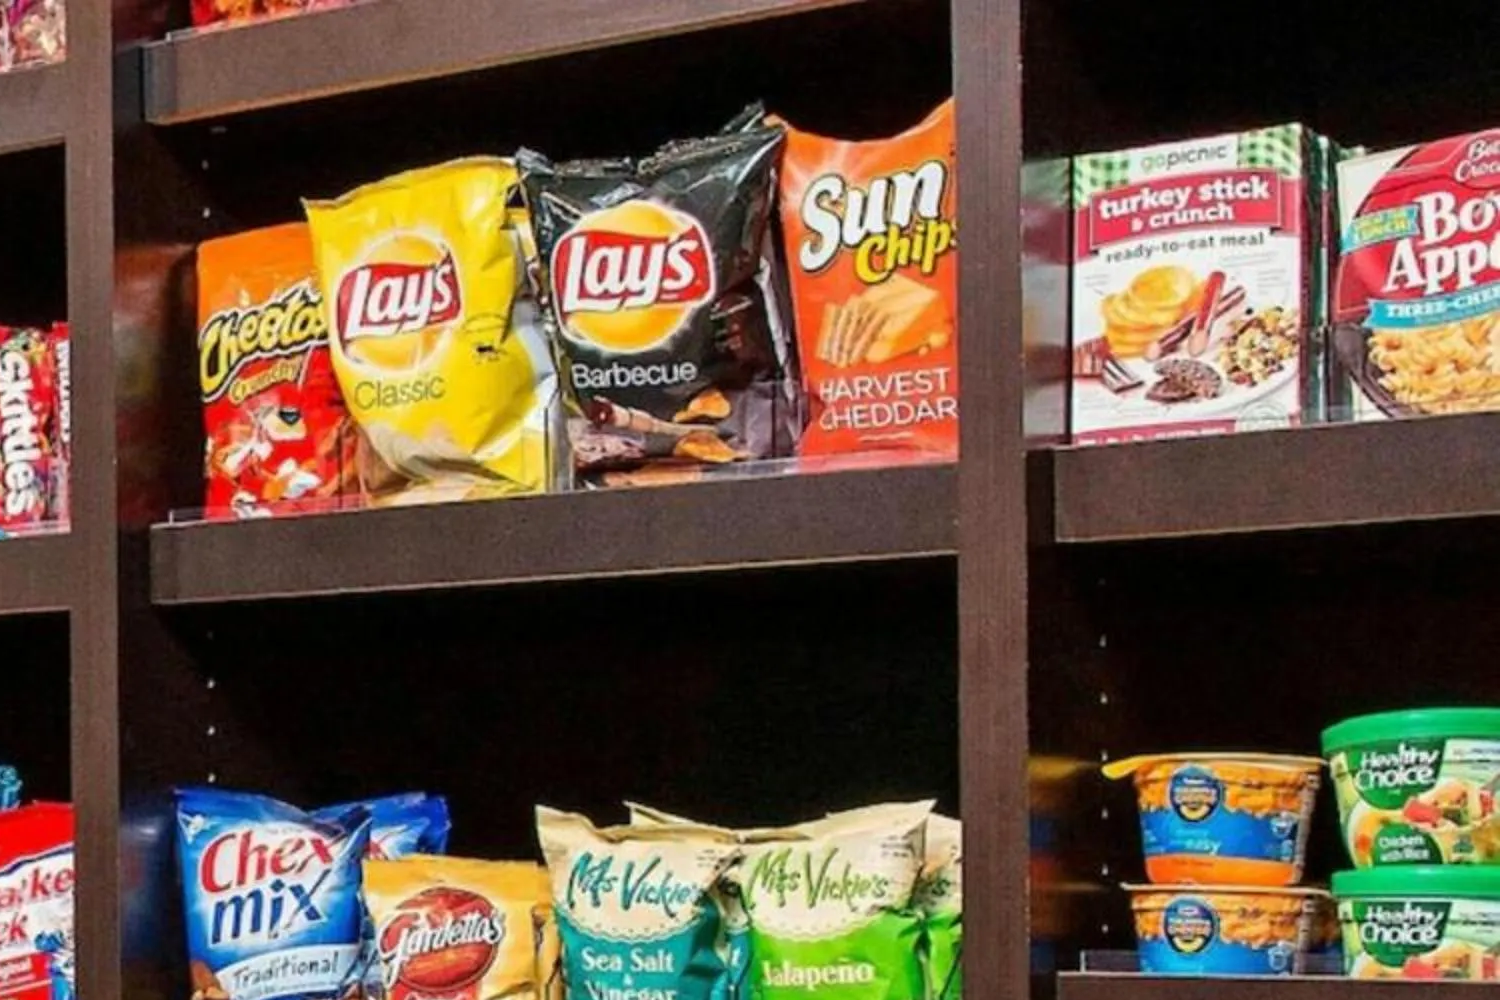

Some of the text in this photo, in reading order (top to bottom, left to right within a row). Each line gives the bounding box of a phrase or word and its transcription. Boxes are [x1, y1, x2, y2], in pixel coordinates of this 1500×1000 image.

[1140, 143, 1230, 173] gopicnic
[1099, 174, 1271, 219] turkey stick
[799, 161, 948, 273] Sun
[1148, 202, 1236, 229] crunch
[1413, 189, 1500, 247] Bo
[1105, 228, 1267, 265] ready-to-eat meal
[562, 228, 701, 313] Lay's
[345, 250, 455, 341] Lay's
[353, 372, 447, 413] Classic
[572, 360, 698, 390] Barbecue
[819, 366, 951, 401] HARVEST
[819, 398, 958, 432] CHEDDAR
[1360, 743, 1440, 768] Healthy
[1355, 767, 1438, 791] Choice
[201, 827, 341, 896] Chex
[210, 869, 331, 945] mix
[1366, 902, 1445, 928] Healthy
[1360, 920, 1441, 946] Choice
[232, 951, 341, 992] Traditional
[580, 946, 675, 973] Sea Salt
[762, 957, 876, 992] Jalapeño
